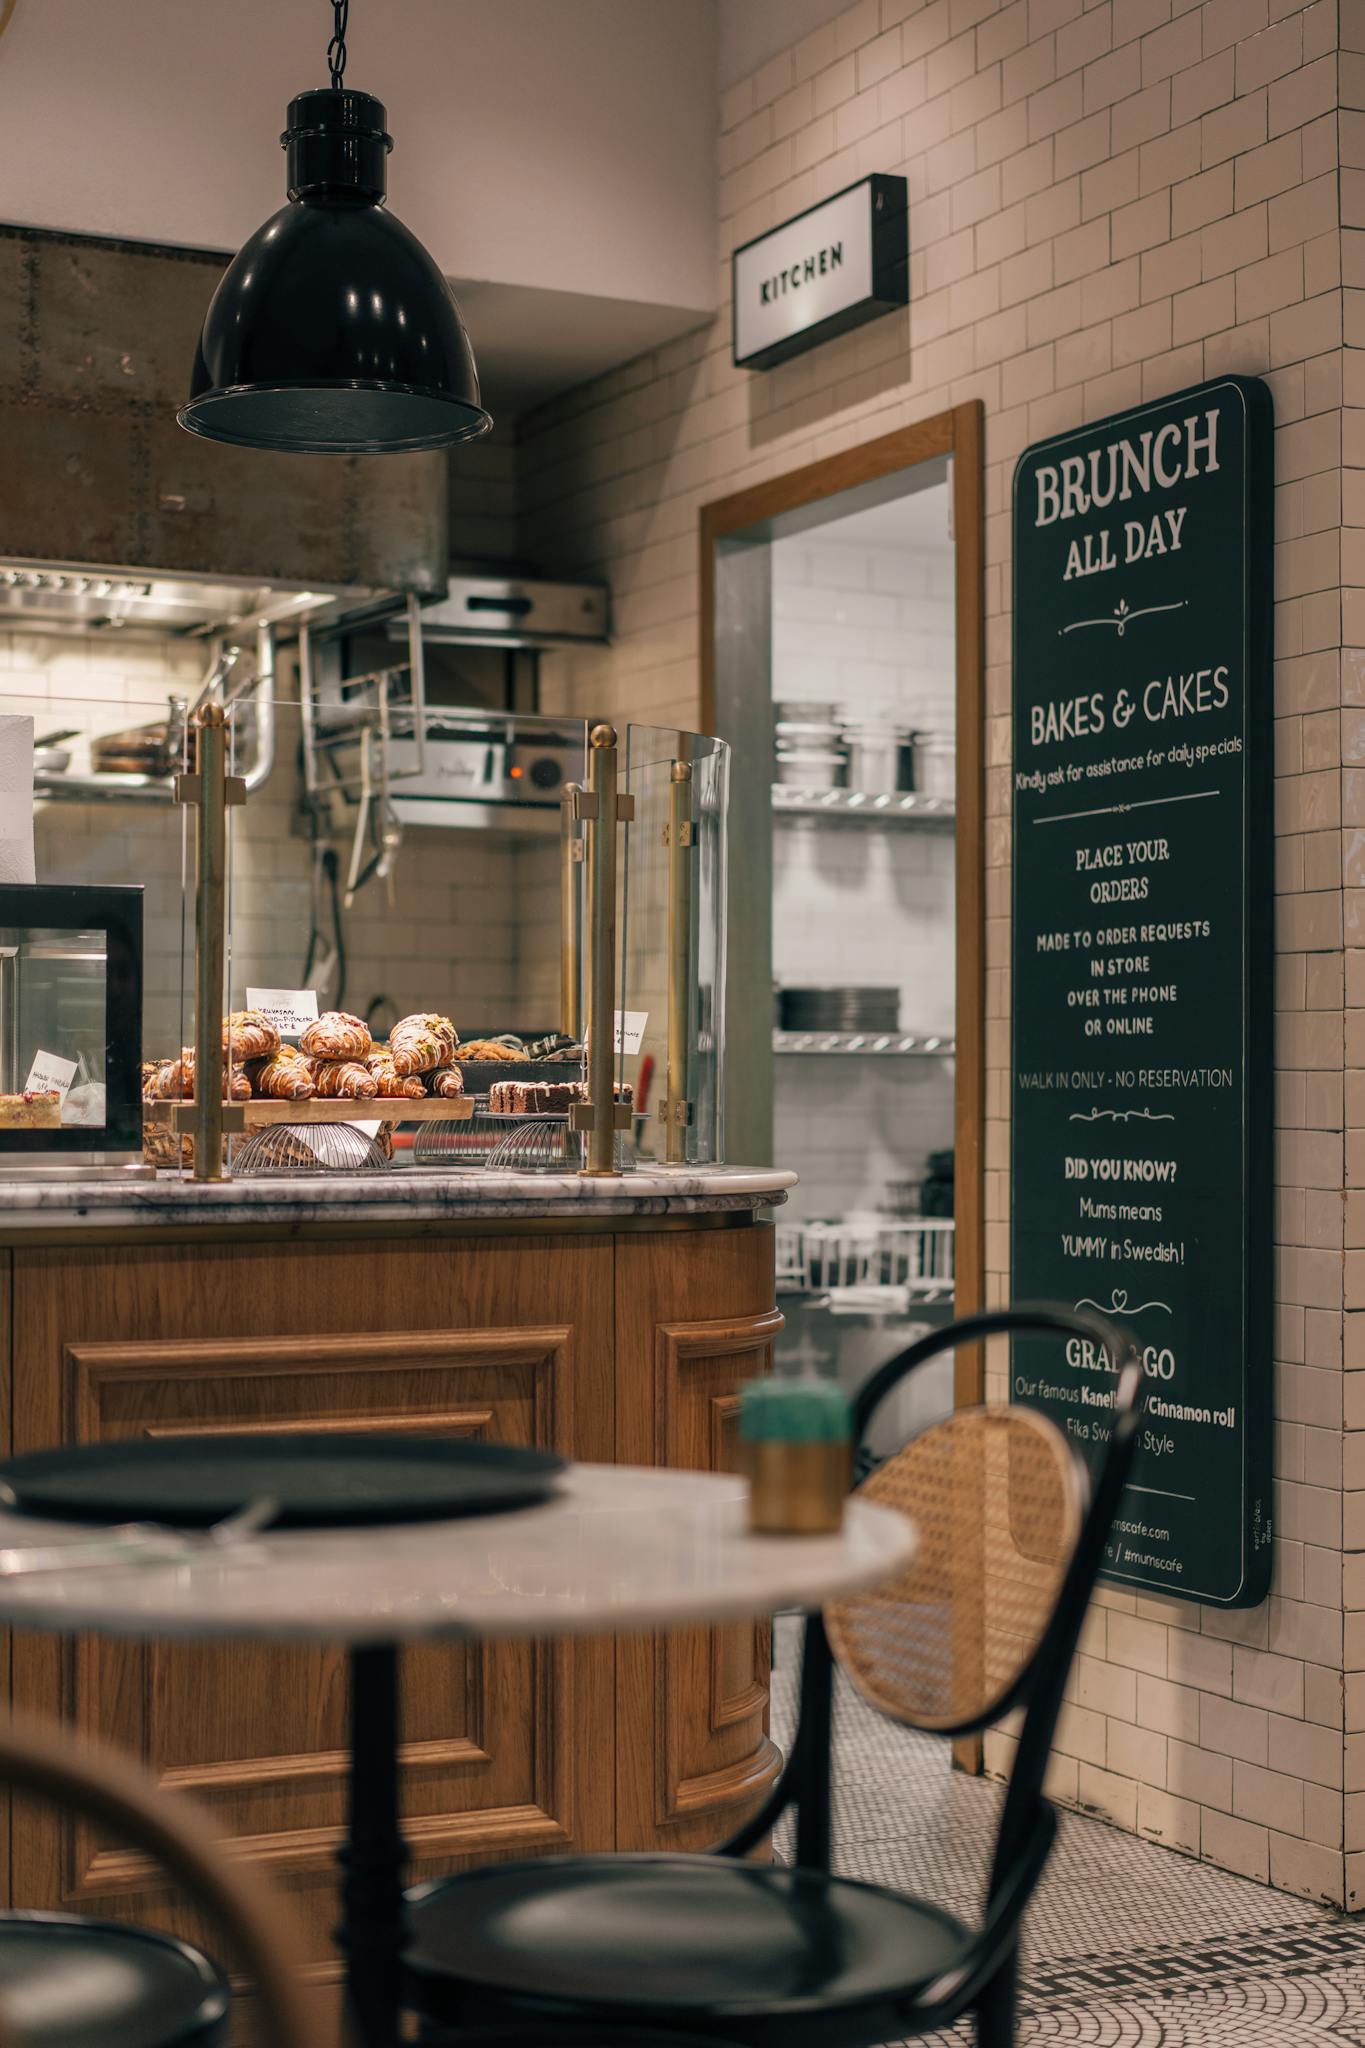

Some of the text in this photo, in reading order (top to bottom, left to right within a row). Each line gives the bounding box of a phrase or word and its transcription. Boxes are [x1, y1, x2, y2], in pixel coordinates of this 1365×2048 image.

[760, 241, 842, 306] KITCHEN
[1035, 409, 1220, 527] BRUNCH
[1063, 507, 1187, 581] ALL DAY
[1031, 666, 1229, 745] BAKES & CAKES
[1016, 736, 1242, 793] Kindly ask for assistance for daily specials
[1076, 838, 1169, 871] PLACE YOUR
[1090, 877, 1149, 904] ORDERS
[1037, 920, 1210, 952] MADE TO ORDER REQUESTS
[1091, 956, 1150, 977] IN STORE
[1067, 985, 1177, 1007] OVER THE PHONE
[1085, 1017, 1153, 1036] OR ONLINE
[1018, 1071, 1053, 1089] WALK
[1056, 1071, 1068, 1089] IN
[1072, 1071, 1104, 1089] ONLY
[1115, 1070, 1135, 1088] NO
[1139, 1069, 1233, 1088] RESERVATION
[1065, 1157, 1177, 1183] DID YOU KNOW?
[1080, 1196, 1162, 1222] Mums means
[1061, 1233, 1107, 1259] YUMMY
[1111, 1241, 1121, 1260] in
[1015, 1376, 1037, 1396] Our
[1038, 1380, 1079, 1403] famous
[1213, 1408, 1235, 1429] roll
[1067, 1418, 1089, 1439] Fika
[1144, 1430, 1175, 1456] Style
[1124, 1548, 1183, 1573] #mumscafe
